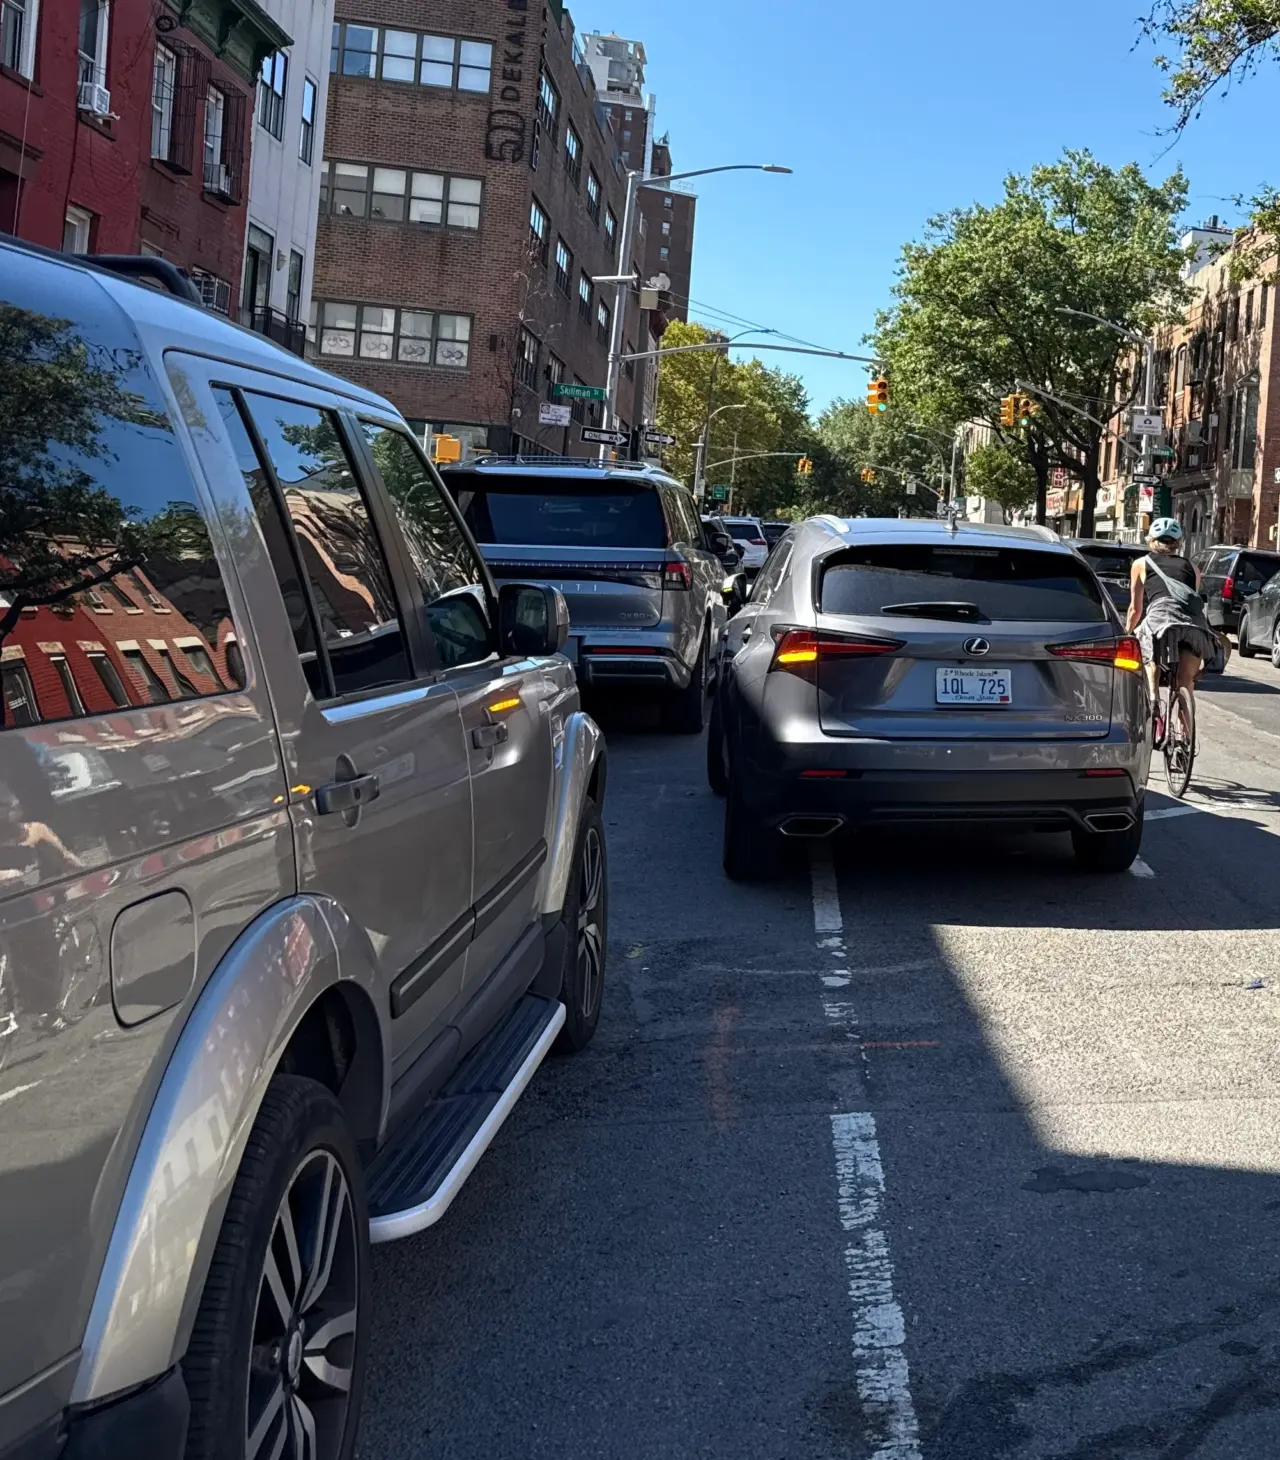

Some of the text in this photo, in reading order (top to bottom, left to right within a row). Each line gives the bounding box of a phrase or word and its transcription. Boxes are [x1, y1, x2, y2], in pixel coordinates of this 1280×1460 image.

[560, 385, 591, 398] Skillman
[588, 432, 623, 443] ONE WAY
[941, 678, 1006, 695] 1QL 725
